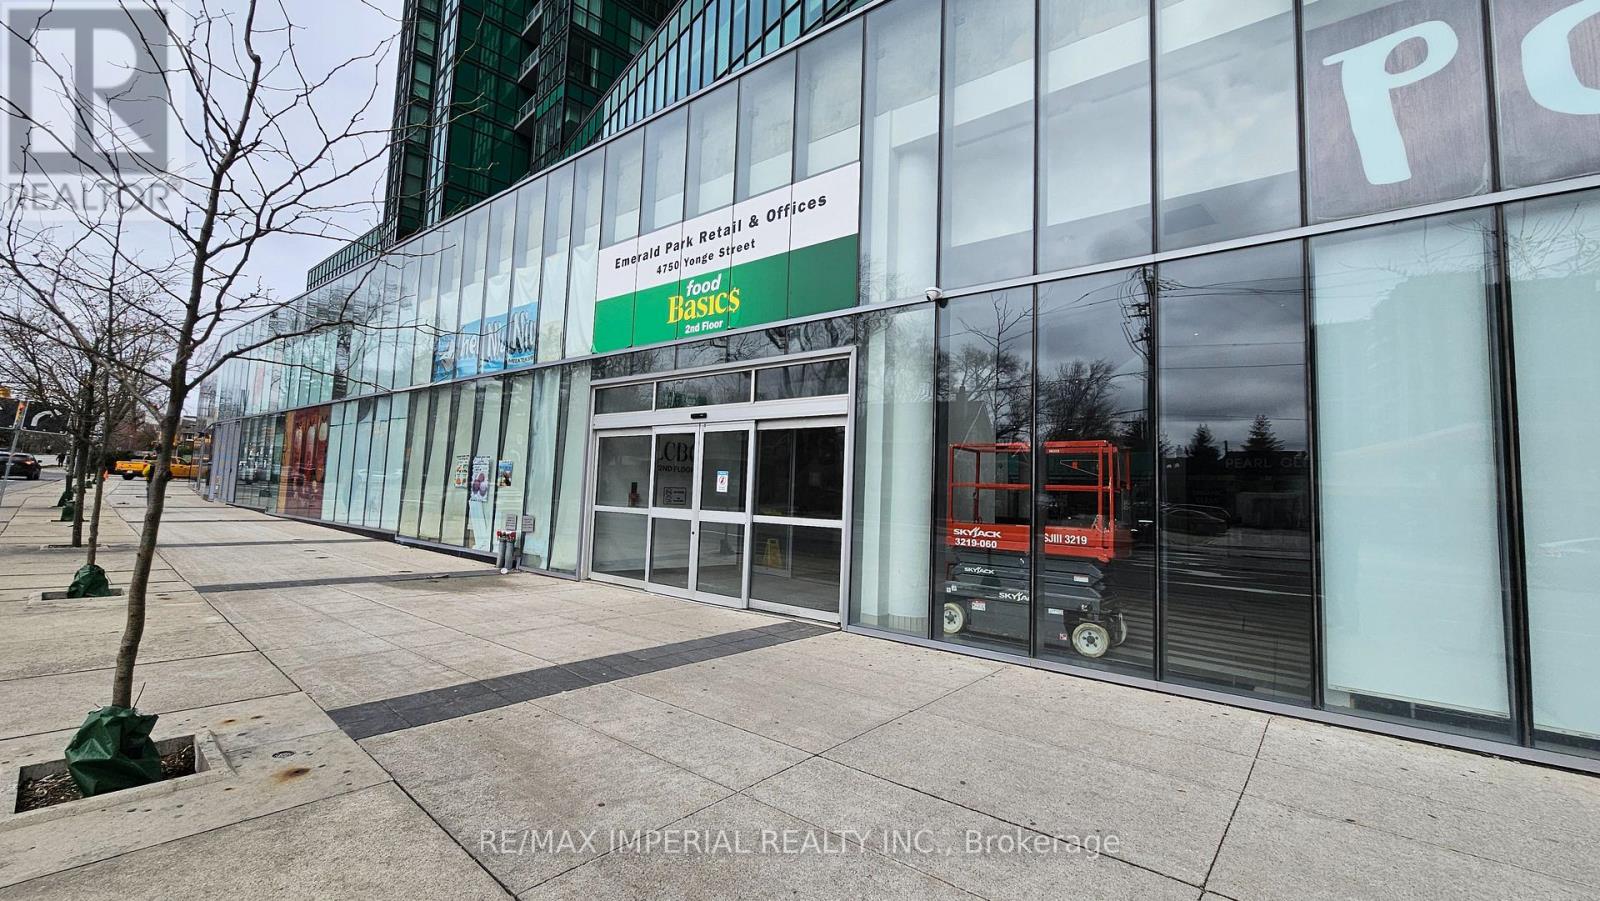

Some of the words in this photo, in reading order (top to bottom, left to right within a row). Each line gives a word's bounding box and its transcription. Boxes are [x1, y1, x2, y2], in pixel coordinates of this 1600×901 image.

[615, 244, 661, 270] Emerald
[665, 235, 694, 254] Park
[699, 219, 742, 244] Retail
[748, 214, 759, 228] &
[766, 195, 828, 224] Offices
[656, 261, 680, 275] 4750
[683, 253, 715, 268] Yonge
[718, 238, 756, 258] Street
[686, 273, 722, 297] food
[684, 323, 701, 334] 2nd
[701, 319, 724, 331] Floor
[1225, 457, 1272, 469] PEARL
[953, 527, 1001, 539] SKYJACK
[1064, 534, 1088, 545] 3219
[955, 538, 997, 549] 3219-060
